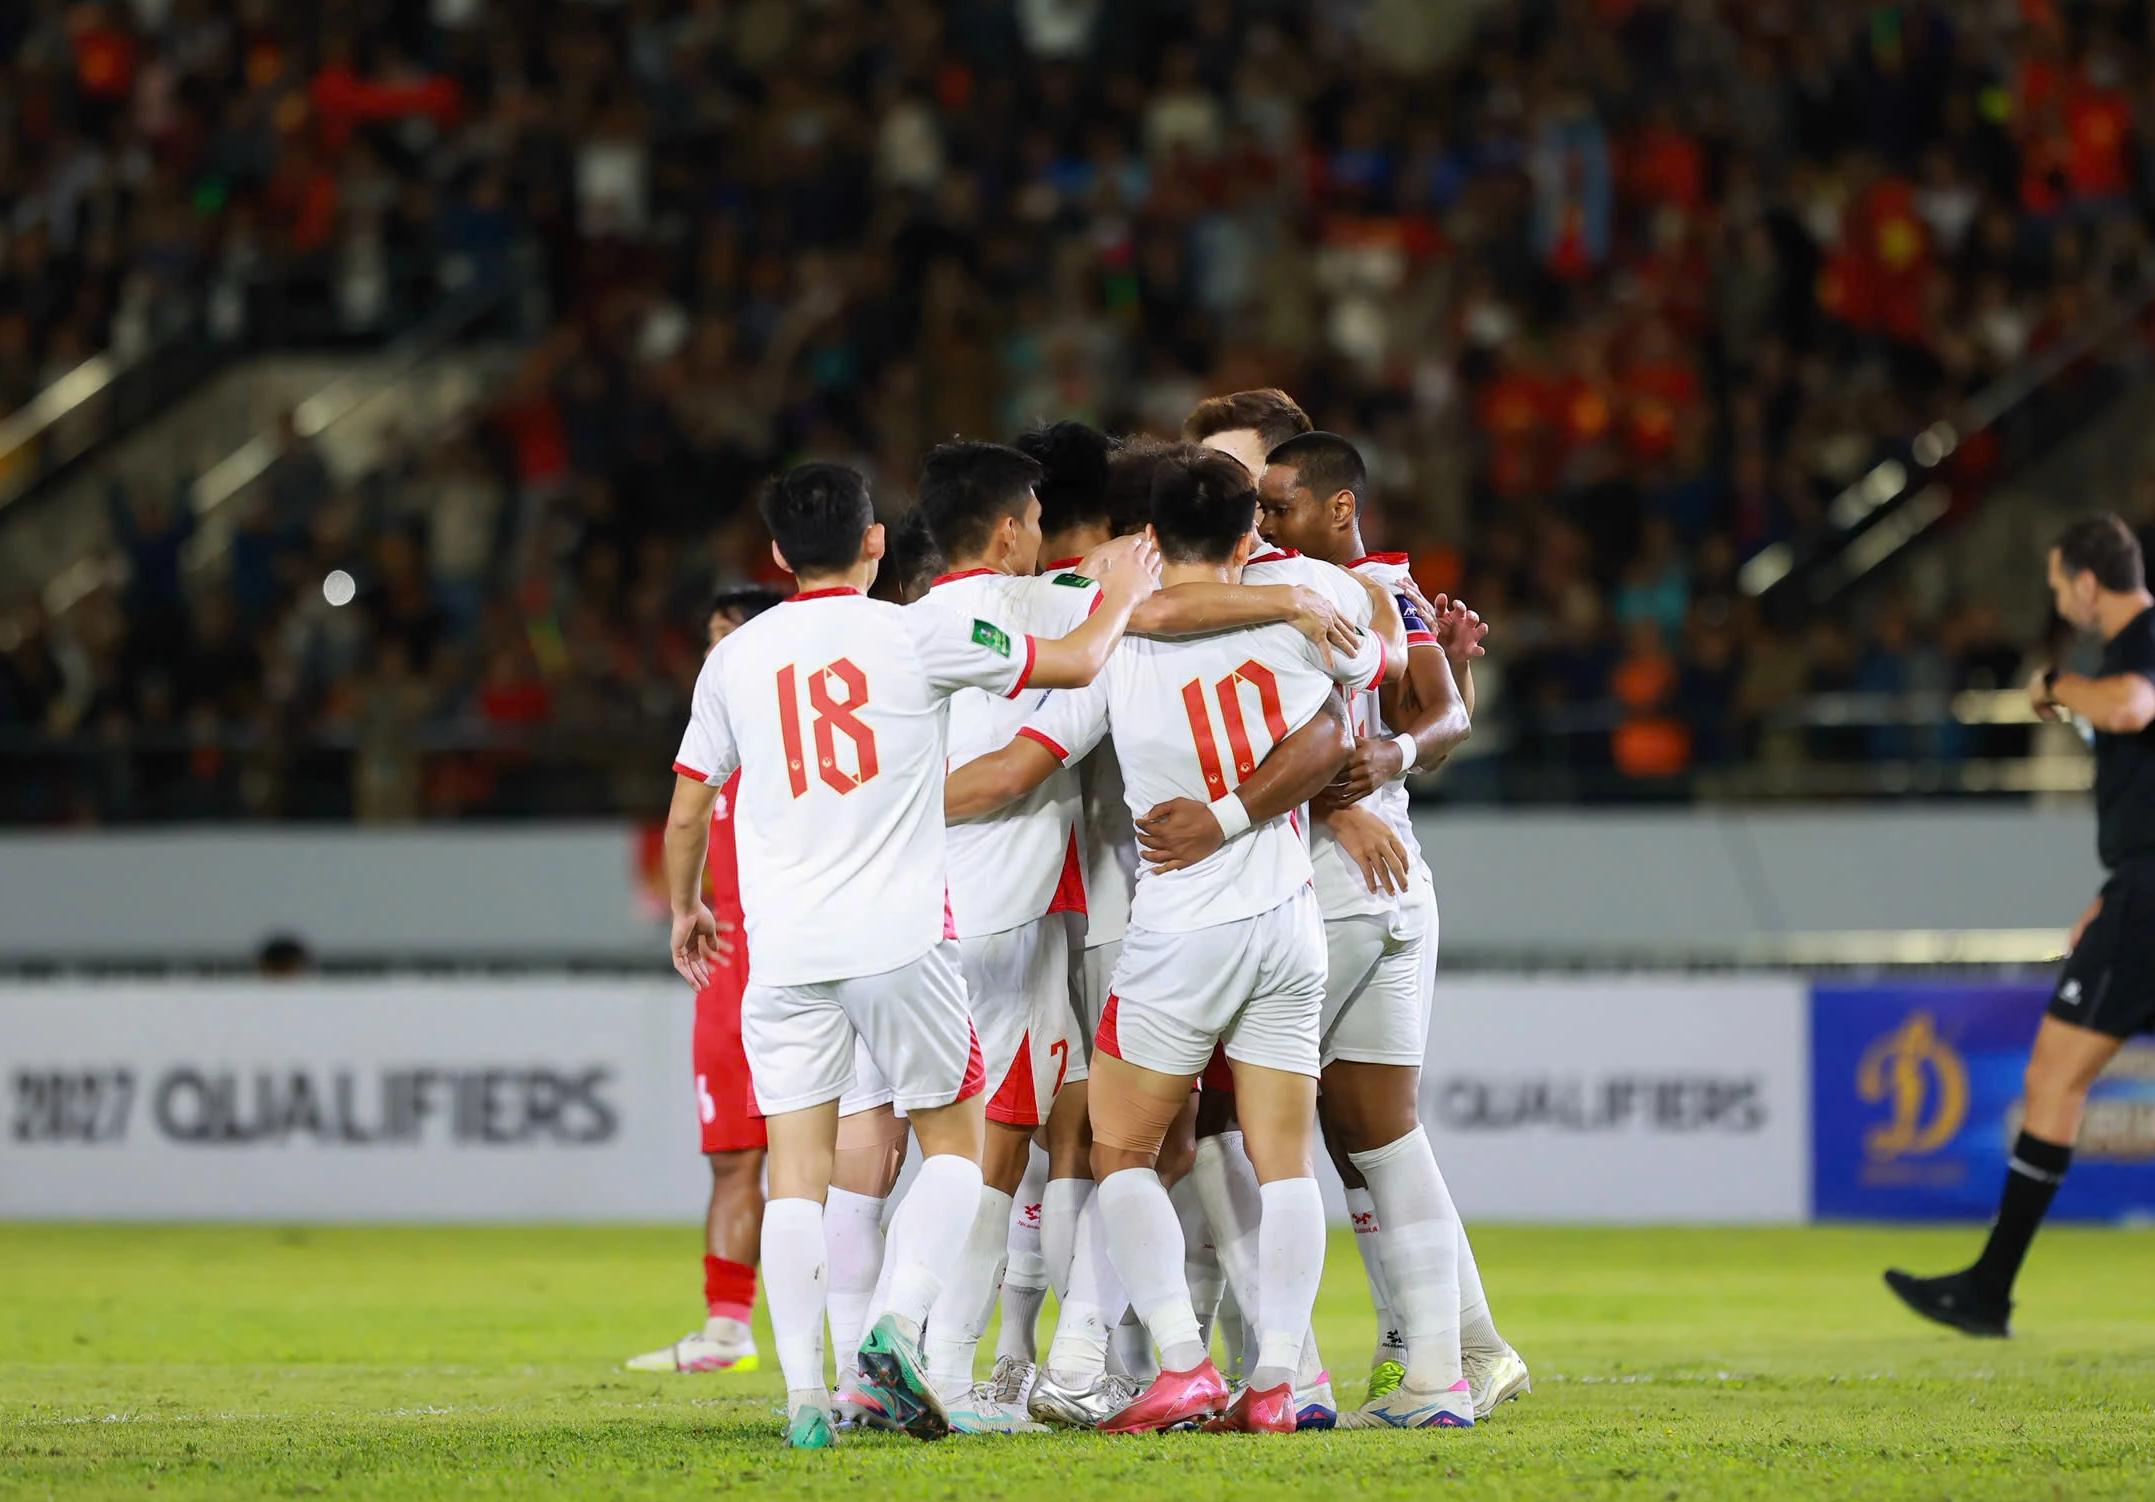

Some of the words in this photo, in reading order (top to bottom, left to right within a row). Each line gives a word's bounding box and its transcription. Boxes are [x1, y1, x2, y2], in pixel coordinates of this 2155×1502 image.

[776, 657, 879, 799] 18
[1182, 659, 1288, 803] 10
[10, 1069, 136, 1143] 2027
[154, 1067, 619, 1146] QUALIFIERS
[1050, 1038, 1068, 1098] 7
[1438, 1073, 1766, 1135] QUALIFIERS
